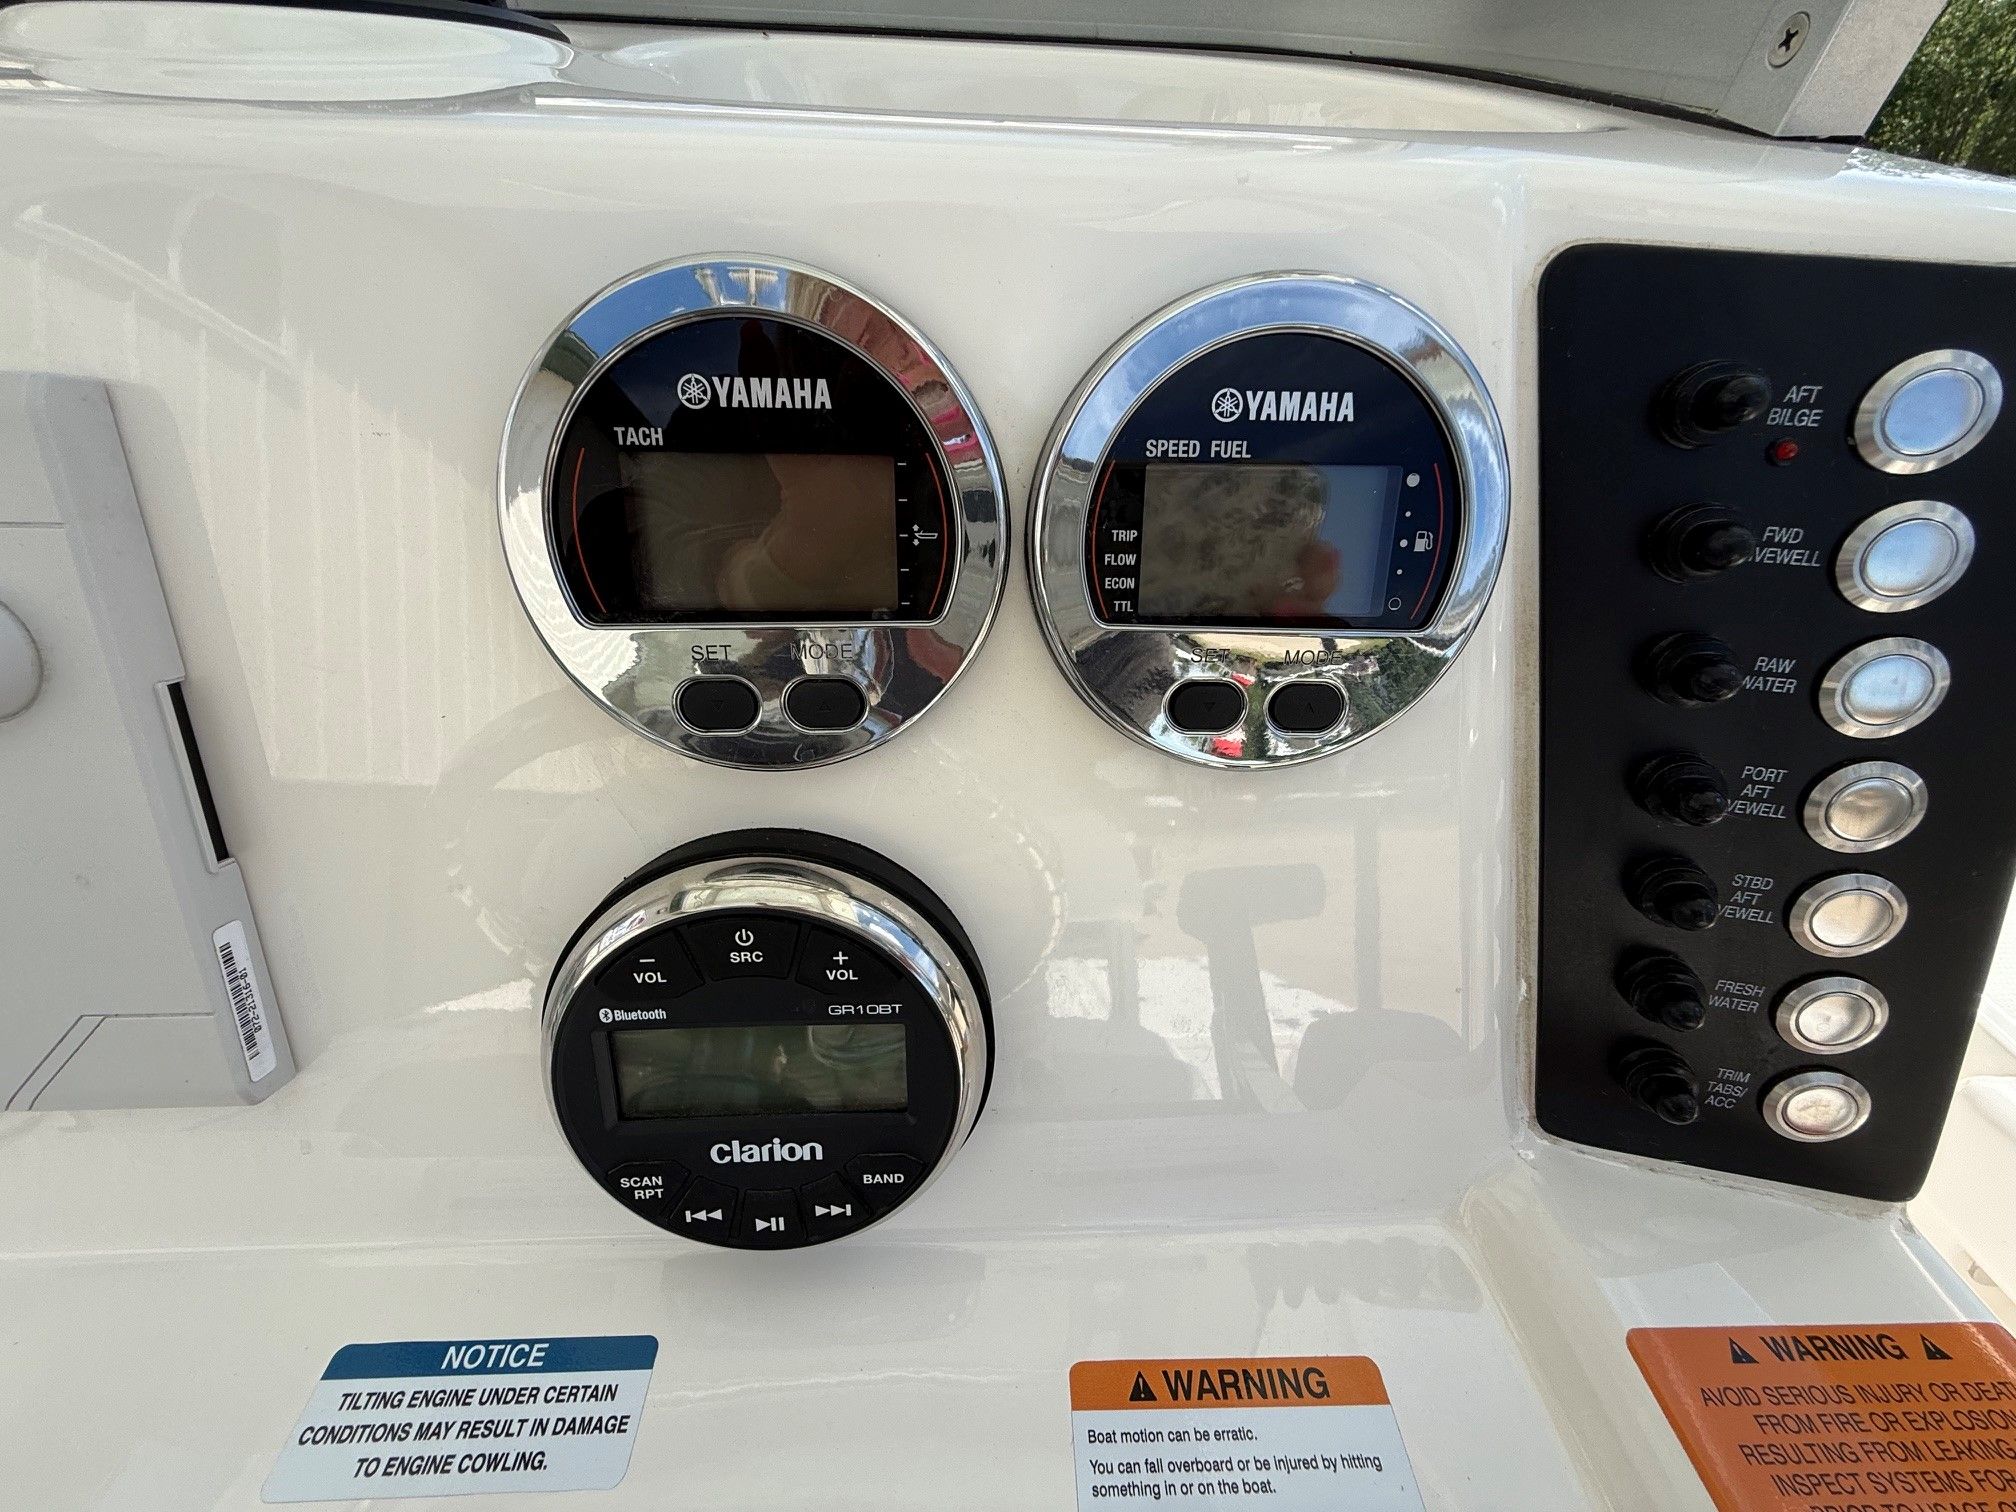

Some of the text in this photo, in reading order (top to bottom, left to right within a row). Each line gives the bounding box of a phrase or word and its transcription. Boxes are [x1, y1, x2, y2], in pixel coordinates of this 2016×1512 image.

[712, 376, 832, 410] YAMAHA
[1783, 385, 1823, 404] AFT
[1246, 391, 1355, 422] YAMAHA
[1766, 408, 1823, 427] BILGE
[613, 426, 664, 447] TACH
[1145, 440, 1251, 458] SPEED FUEL
[1111, 529, 1138, 542] TRIP
[1762, 526, 1804, 544] FWD
[1104, 553, 1137, 566] FLOW
[1755, 547, 1820, 567] VEWELL
[1104, 577, 1135, 590] ECON
[1113, 601, 1134, 613] TTL
[691, 644, 732, 662] SET
[790, 643, 853, 661] MODE
[1190, 648, 1229, 664] SET
[1283, 649, 1343, 666] MODE
[1754, 656, 1797, 674] RAW
[1741, 766, 1789, 783] PORT
[1740, 784, 1775, 799] AFT
[1727, 799, 1787, 819] VEWELL
[1732, 873, 1774, 890] STBD
[1730, 890, 1763, 905] AFT
[730, 951, 764, 963] SRC
[633, 970, 667, 983] VOL
[826, 969, 858, 981] VOL
[1714, 979, 1766, 998] FRESH
[1708, 995, 1759, 1014] WATER
[613, 1007, 667, 1022] Bluetooth
[1717, 1068, 1750, 1084] TRIM
[1707, 1081, 1749, 1098] TABS/
[1704, 1096, 1737, 1109] ACC
[710, 1137, 823, 1164] clarion
[620, 1175, 663, 1188] SCAN
[863, 1173, 904, 1185] BAND
[634, 1188, 664, 1200] RPT
[441, 1343, 549, 1370] NOTICE
[1760, 1333, 1909, 1362] WARNING
[1162, 1367, 1331, 1401] WARNING
[337, 1384, 619, 1411] TILTING ENGINE UNDER CERTAIN
[1699, 1386, 1760, 1407] AVOID
[1762, 1385, 1857, 1406] SERIOUS
[1852, 1383, 1928, 1404] INJURY
[1928, 1382, 1967, 1402] OR
[298, 1415, 631, 1446] CONDITIONS MAY RESULT IN DAMAGE
[1753, 1409, 2016, 1435] FROM FIRE OR EXPLOSION
[1087, 1427, 1258, 1445] Boat motion can be erratic.
[1738, 1438, 2016, 1466] RESULTING FROM LEAKING
[353, 1450, 548, 1478] TO ENGINE COWLING.
[1089, 1453, 1383, 1475] You can fall overboard or be injured by hitting
[1092, 1478, 1277, 1499] something in or on the boat.
[1770, 1469, 2016, 1497] INSPECT SYSTEMS FOR
